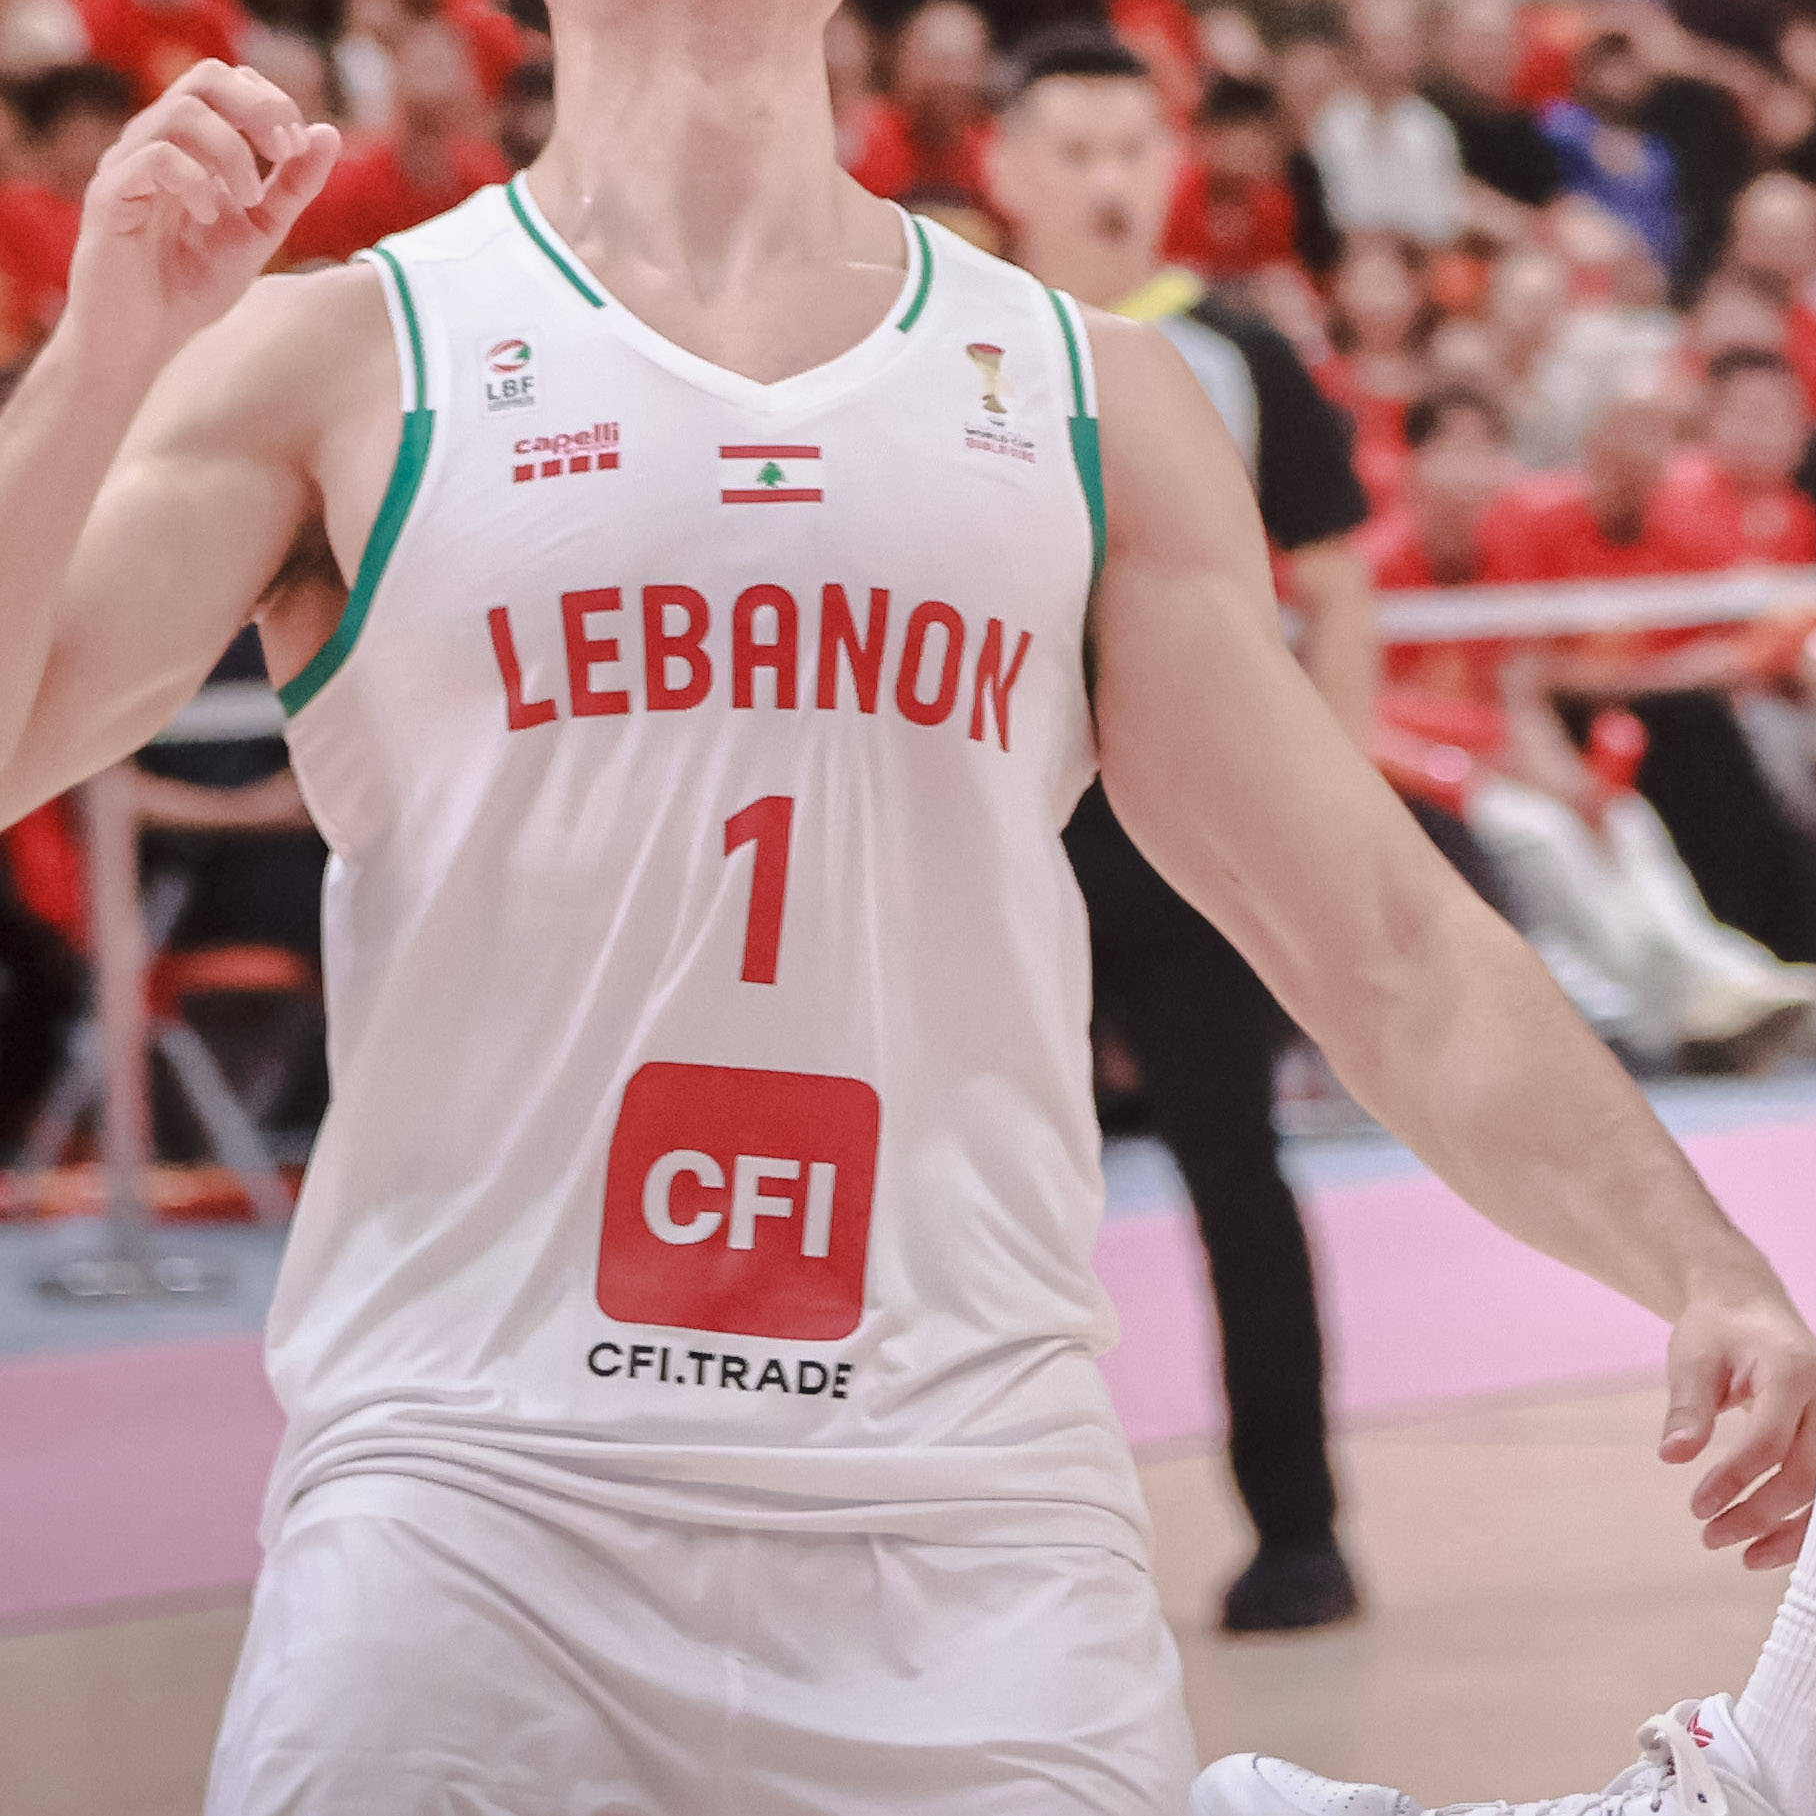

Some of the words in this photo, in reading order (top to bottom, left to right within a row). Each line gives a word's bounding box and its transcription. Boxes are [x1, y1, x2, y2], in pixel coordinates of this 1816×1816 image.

[486, 376, 535, 401] LBF
[513, 421, 620, 454] capelli
[488, 582, 1033, 754] LEBANON
[724, 795, 795, 985] 1
[642, 1148, 838, 1259] CFI
[588, 1342, 855, 1400] CFI.TRADE
